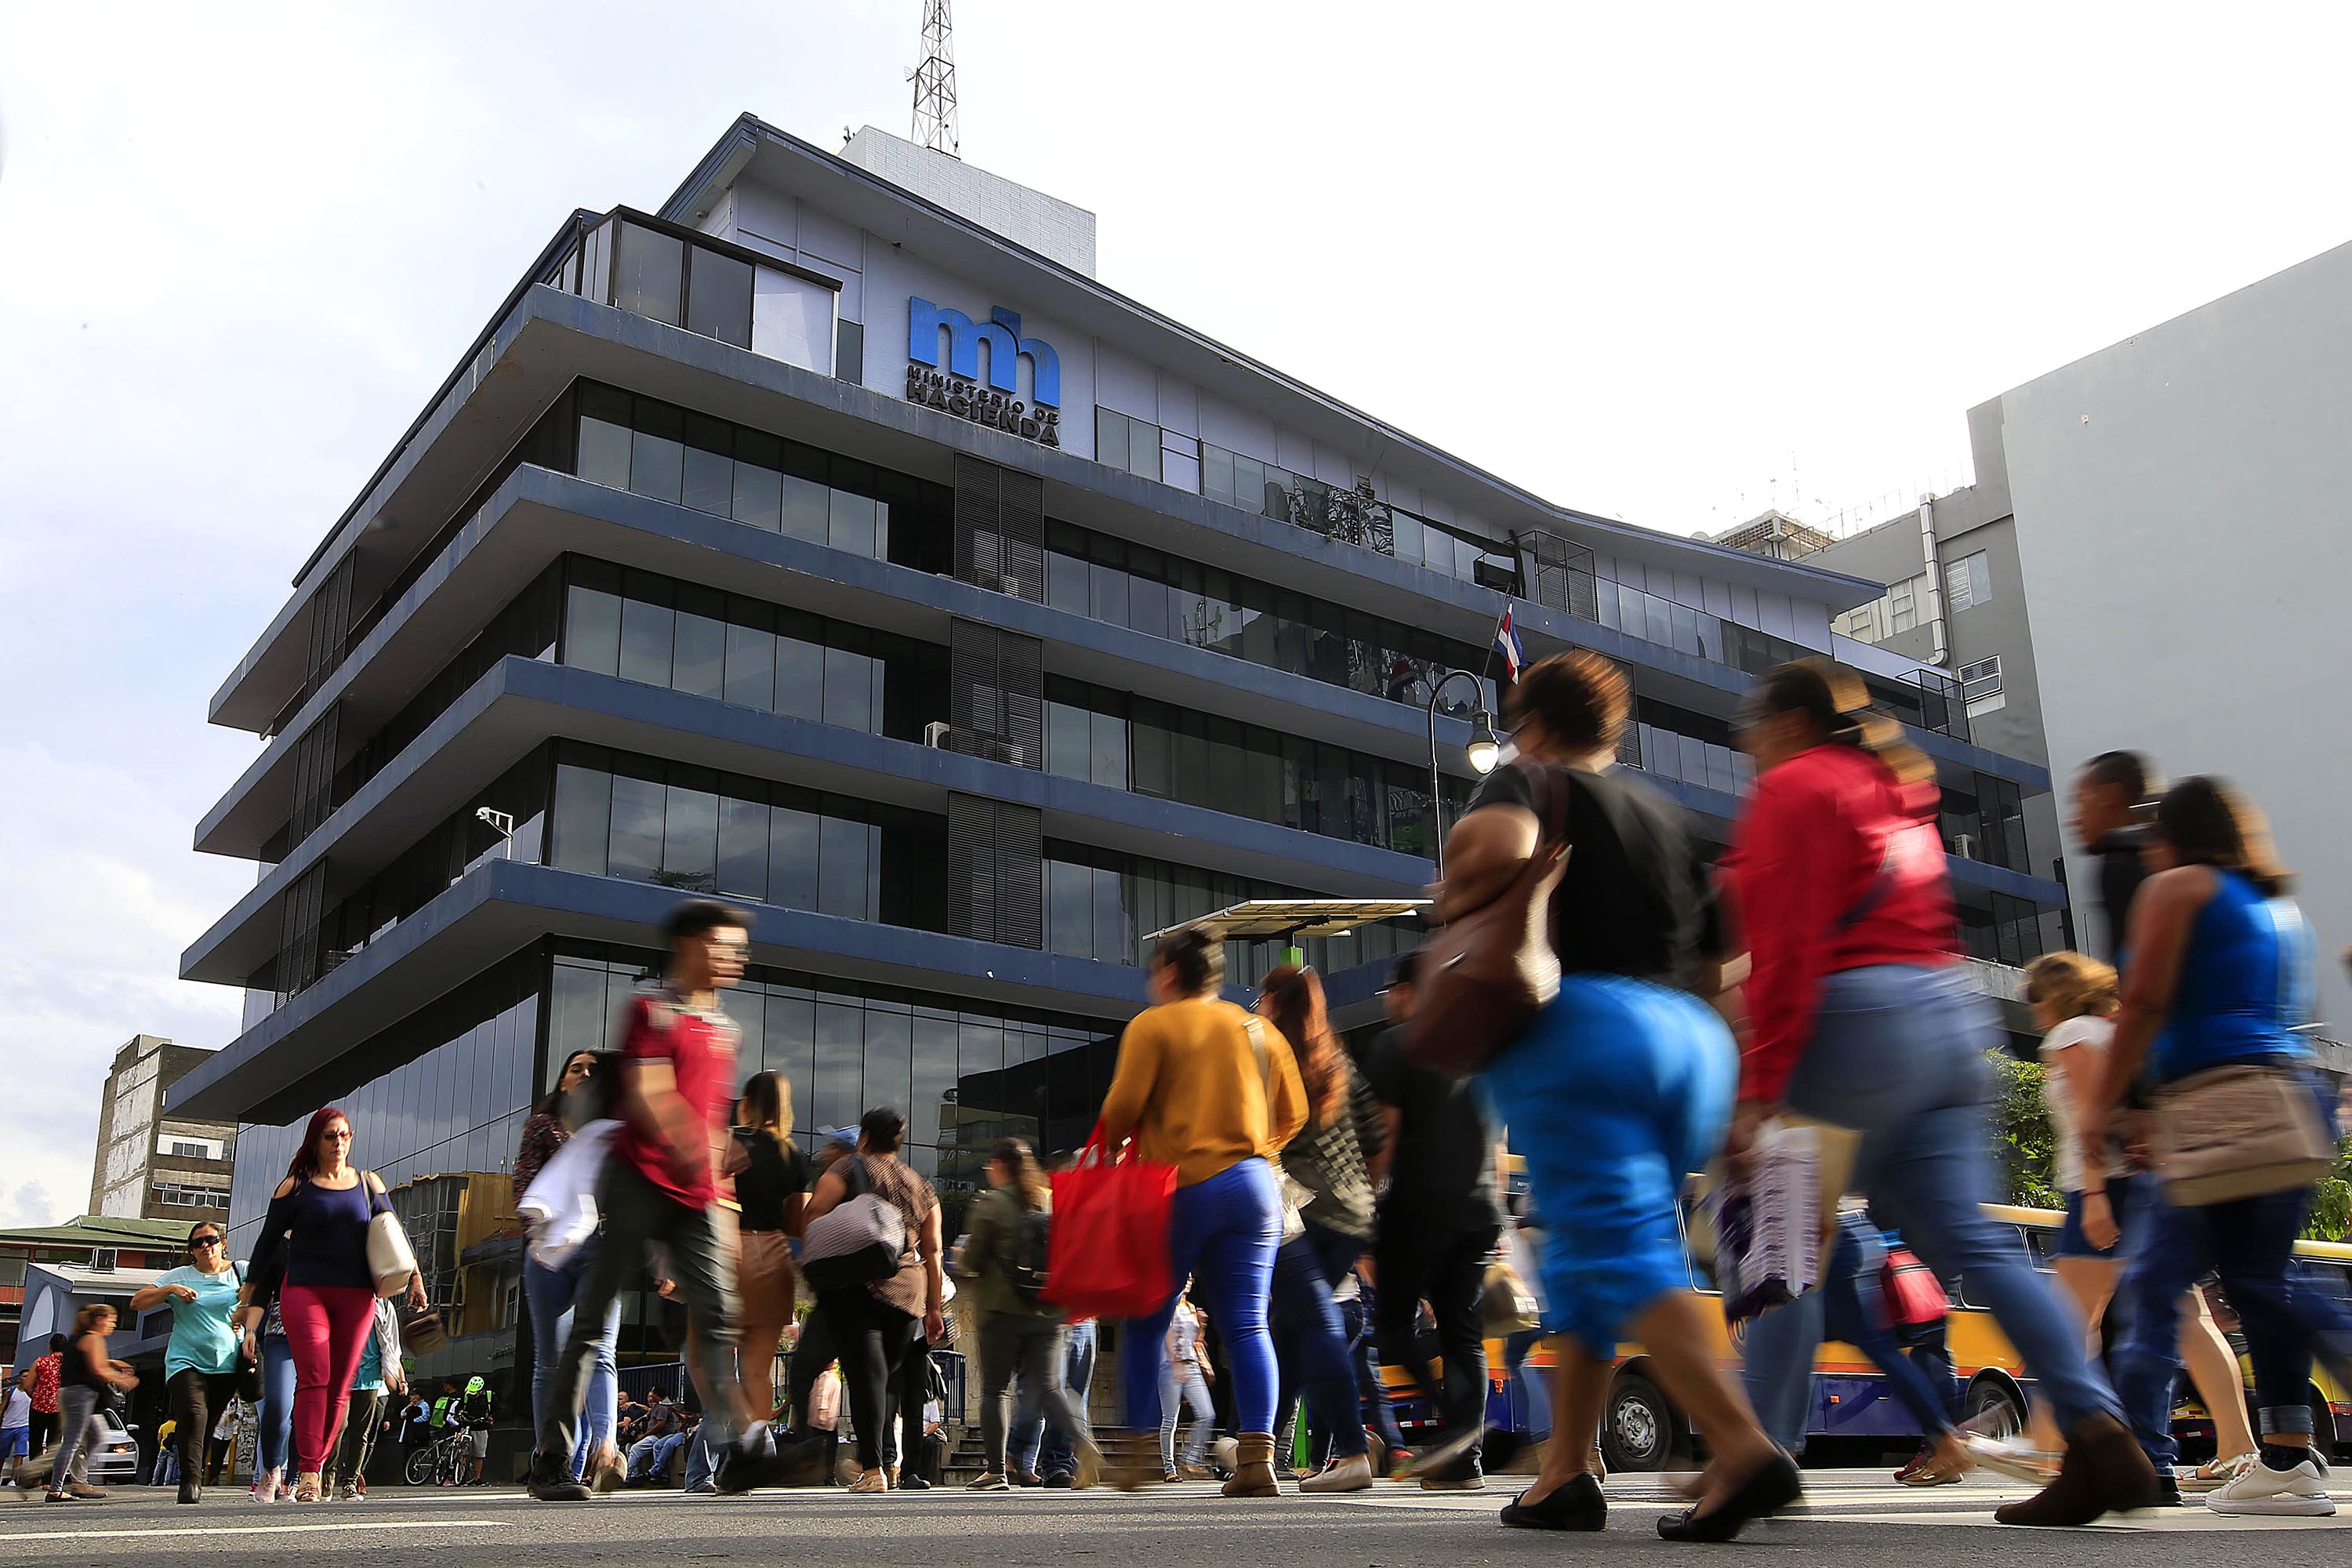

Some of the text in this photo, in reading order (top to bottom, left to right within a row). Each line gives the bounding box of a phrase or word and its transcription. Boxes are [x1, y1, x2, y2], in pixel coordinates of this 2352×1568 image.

[906, 379, 1059, 447] HACIENDA
[907, 365, 1059, 426] MINISTERIO DE
